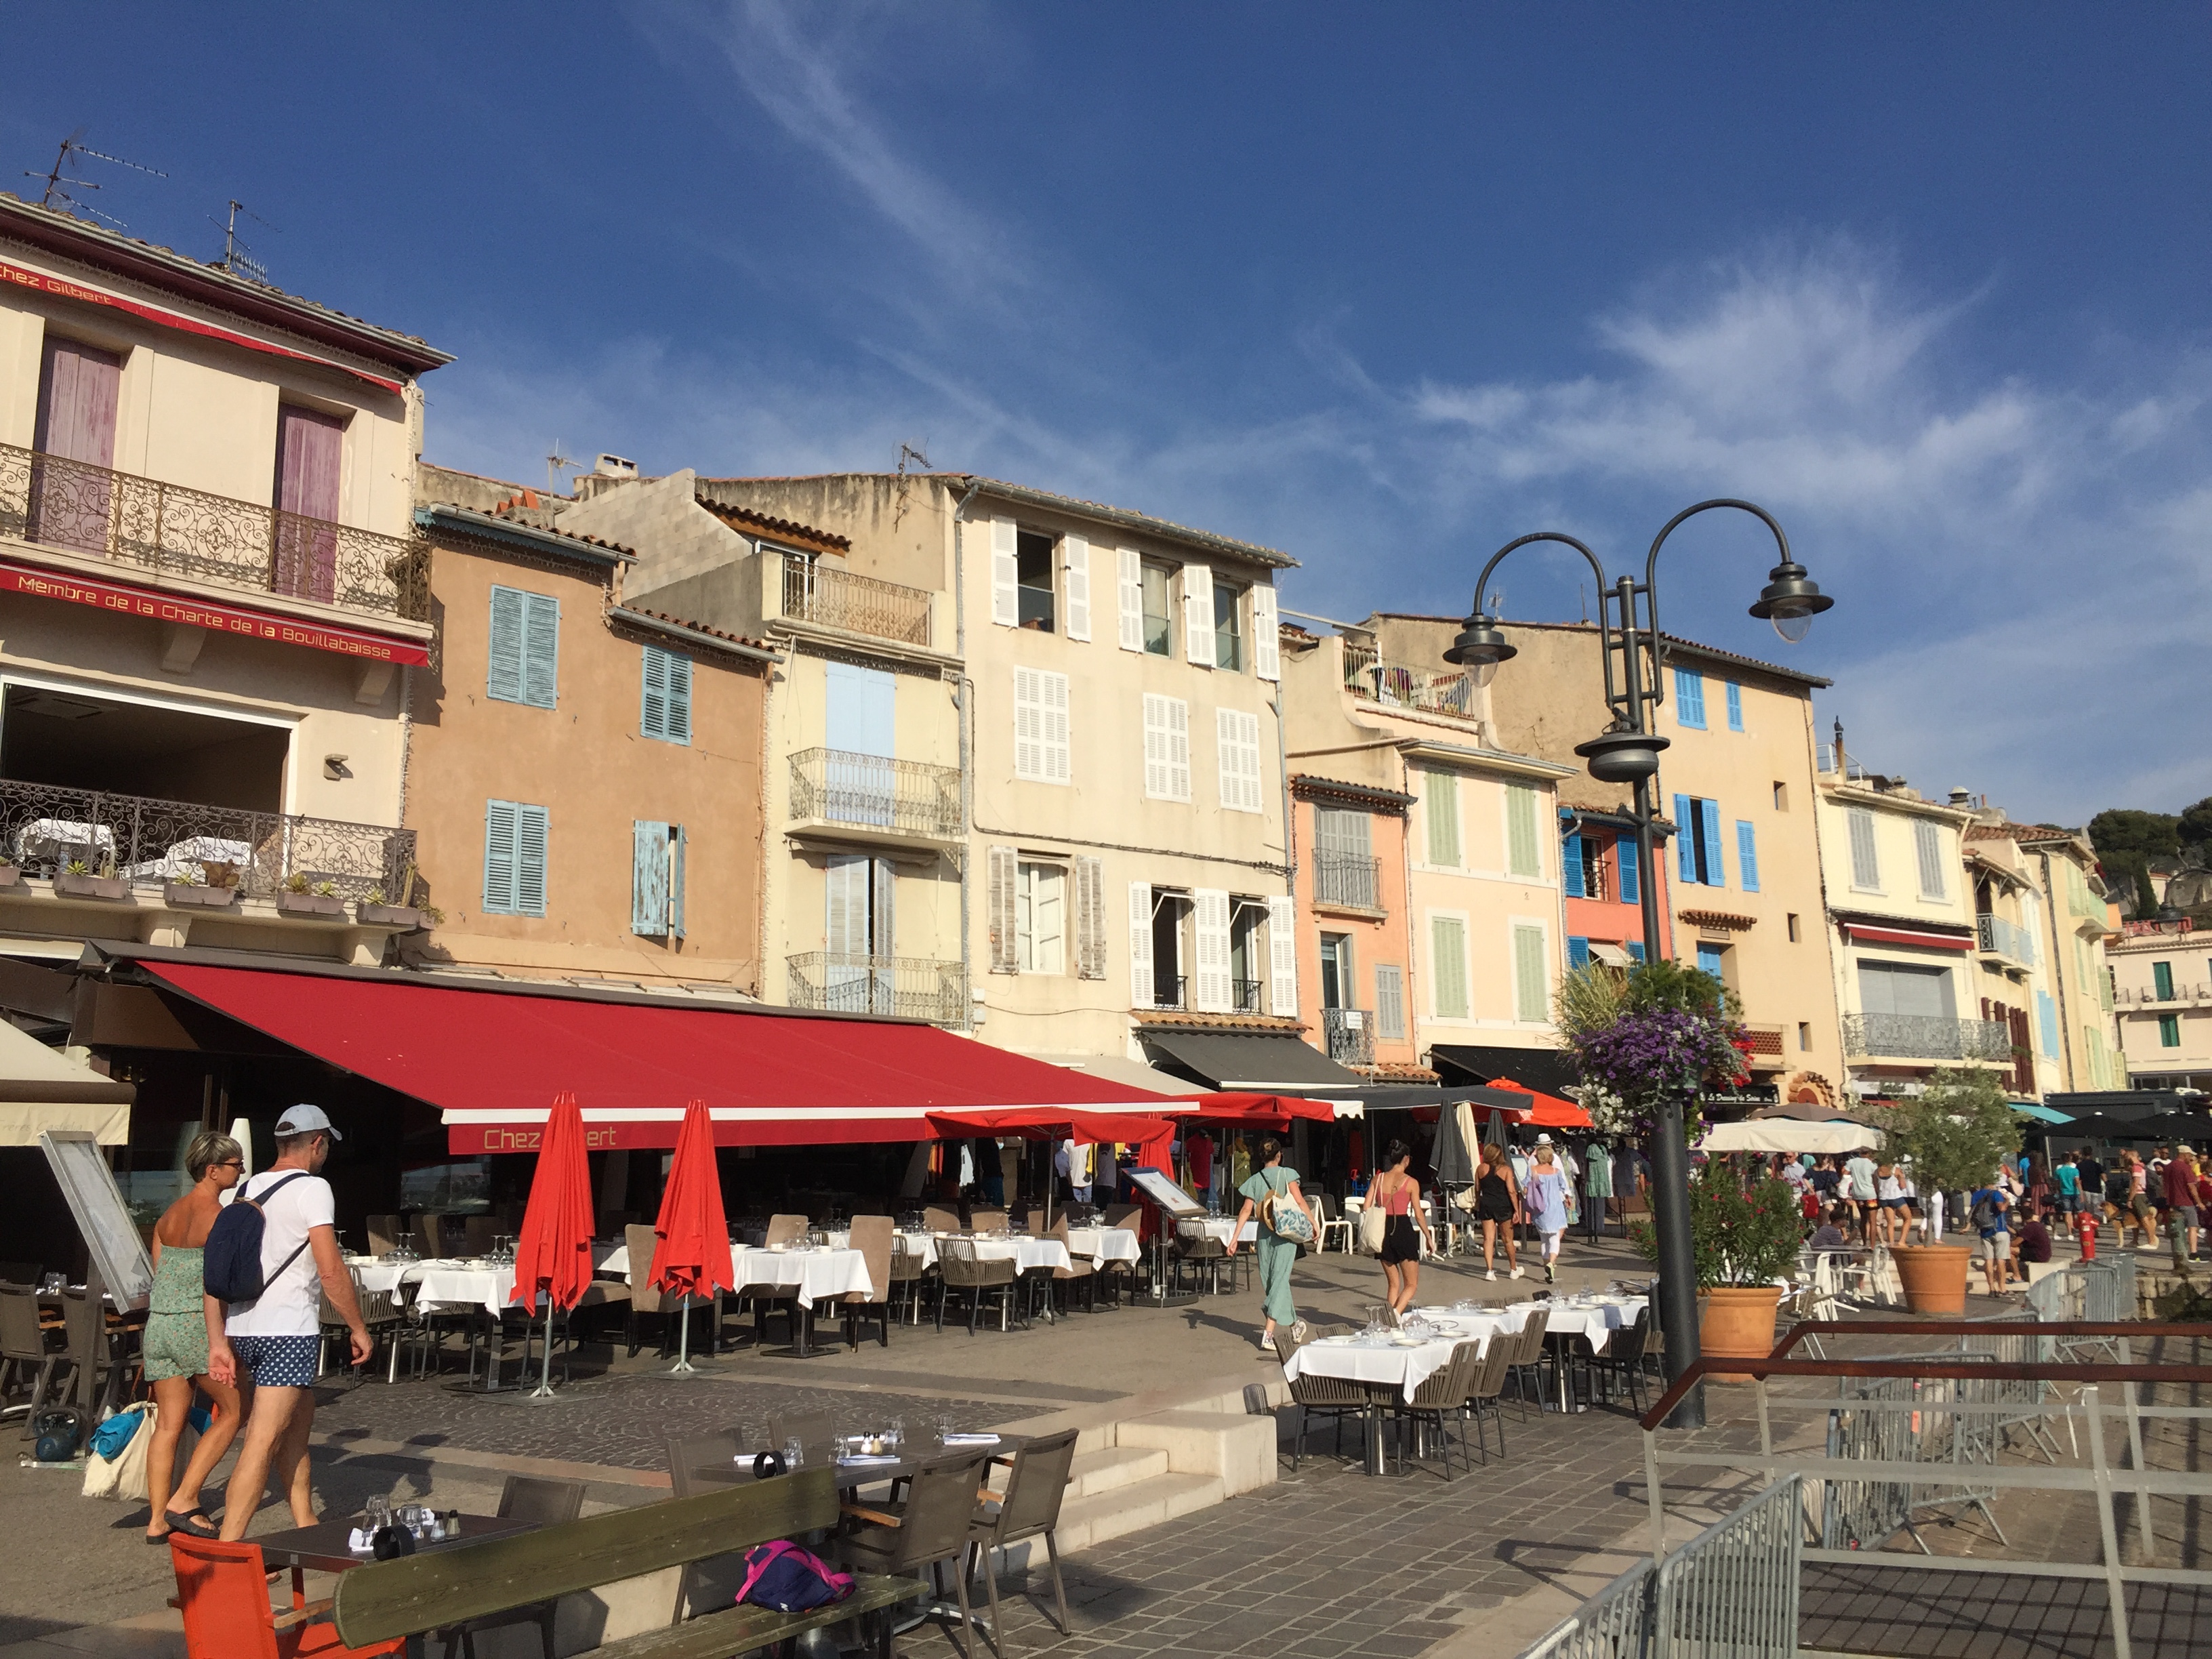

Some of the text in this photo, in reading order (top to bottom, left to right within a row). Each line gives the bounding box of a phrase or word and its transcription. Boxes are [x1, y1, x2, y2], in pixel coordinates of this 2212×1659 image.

[47, 280, 112, 304] Gilbert
[18, 576, 391, 659] Membre de la Charte de la Bouillabaisse
[484, 1128, 541, 1149] Chez
